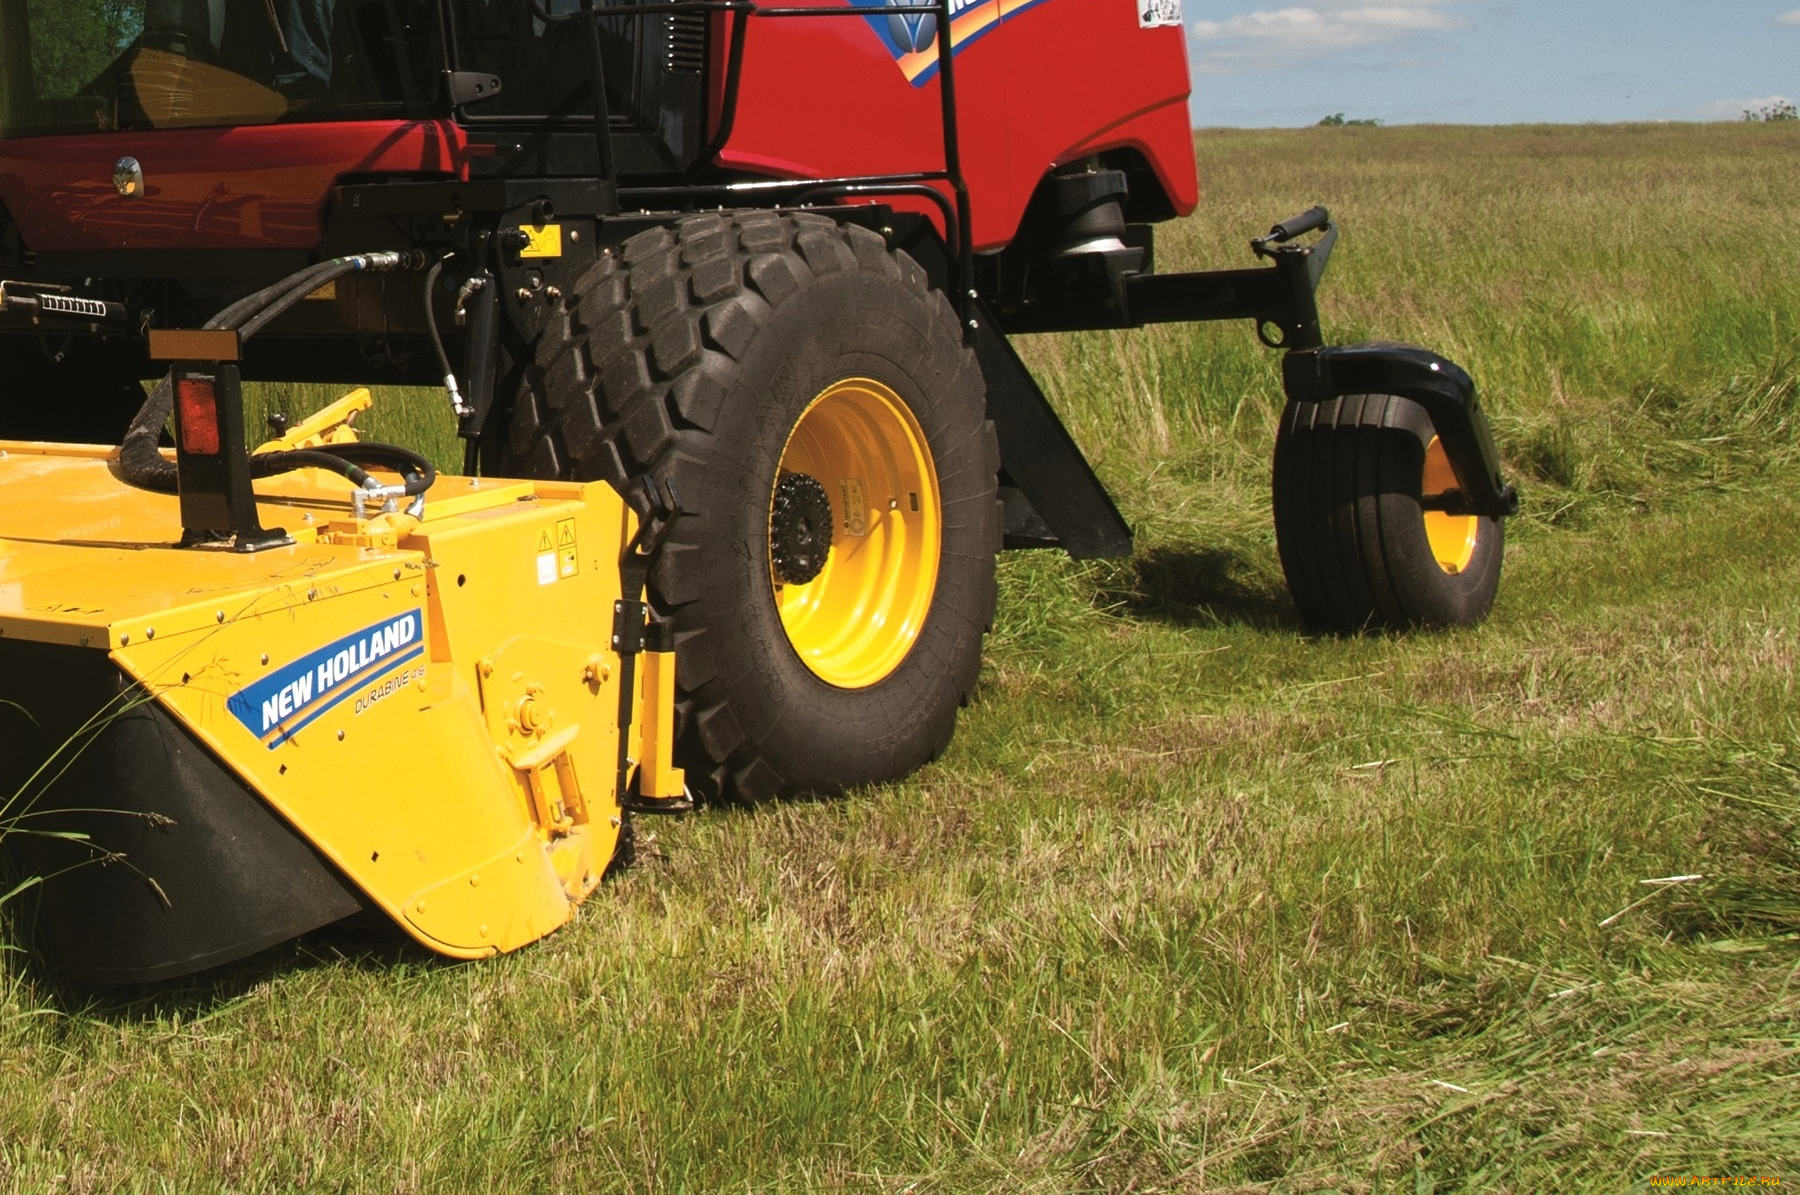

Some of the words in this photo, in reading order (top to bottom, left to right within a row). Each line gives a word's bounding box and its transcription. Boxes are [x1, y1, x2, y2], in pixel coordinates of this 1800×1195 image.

[262, 670, 313, 732] NEW
[317, 615, 415, 693] HOLLAND
[355, 670, 410, 714] DURABINE
